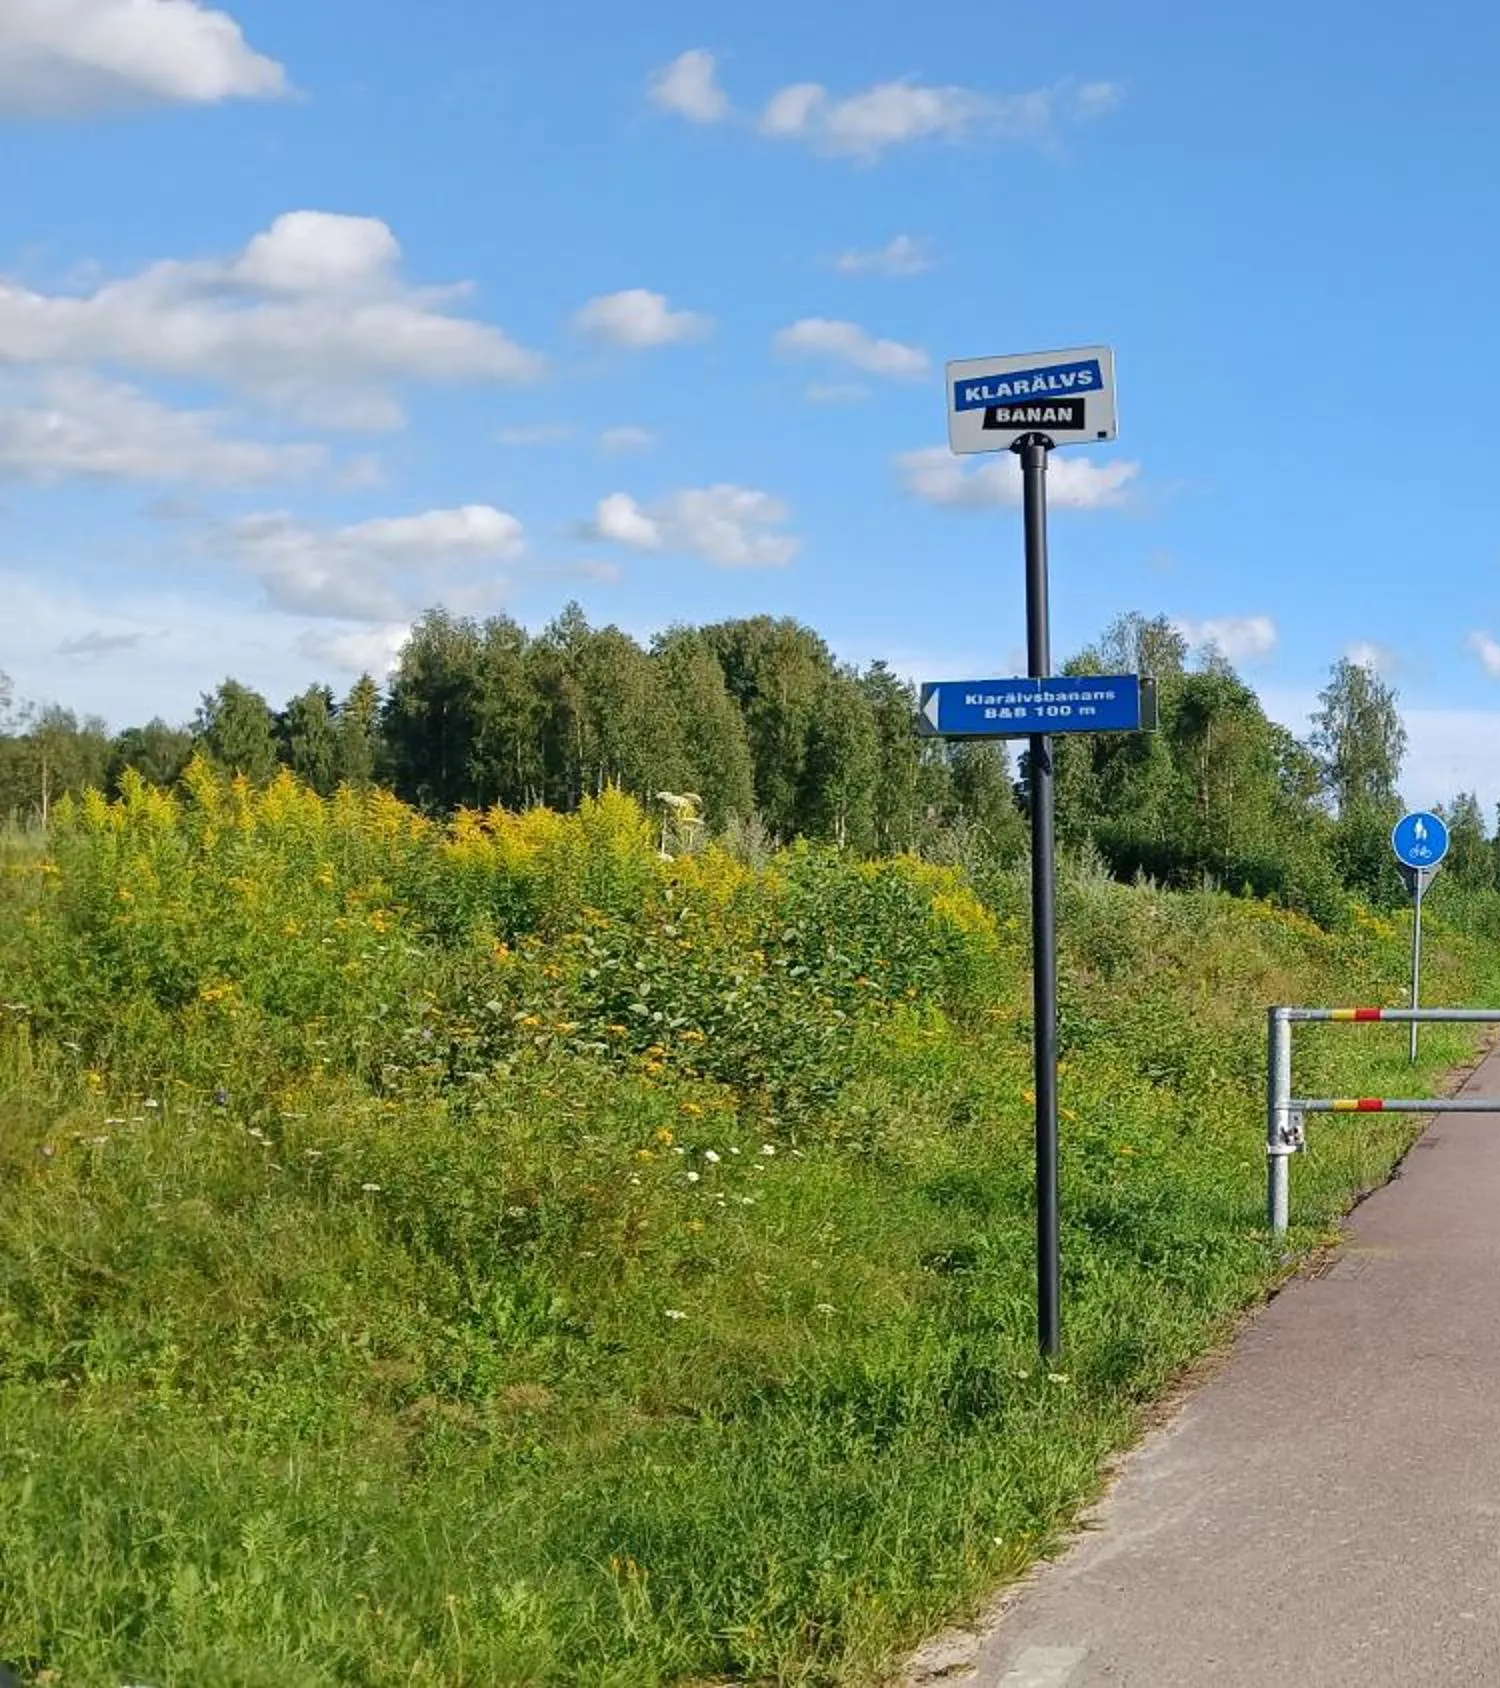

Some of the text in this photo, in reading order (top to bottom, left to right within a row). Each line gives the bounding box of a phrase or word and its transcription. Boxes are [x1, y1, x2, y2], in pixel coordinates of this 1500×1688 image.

[964, 369, 1093, 402] KLARÄLVS
[995, 407, 1073, 422] BANAN
[965, 689, 1117, 705] Klarälvsbanans
[984, 705, 1096, 719] B&B 100 m
